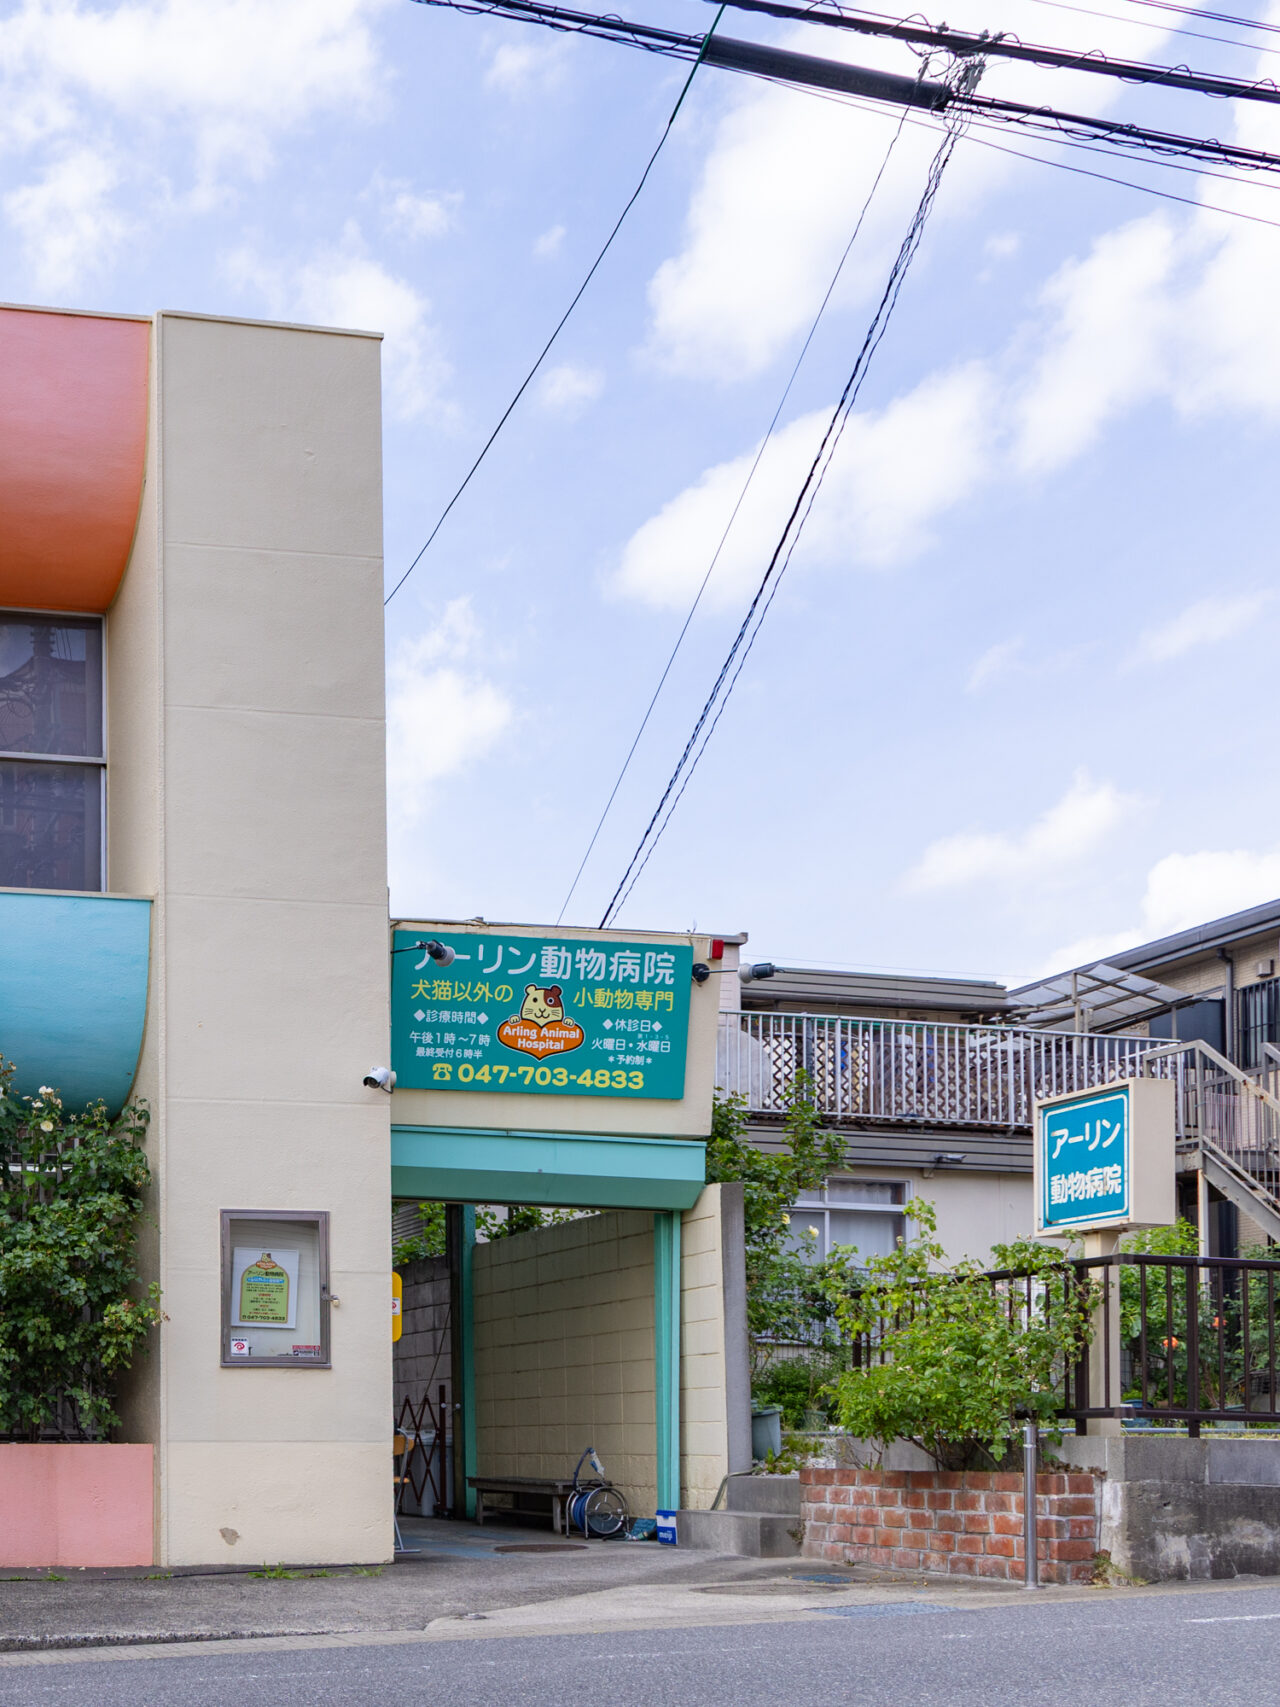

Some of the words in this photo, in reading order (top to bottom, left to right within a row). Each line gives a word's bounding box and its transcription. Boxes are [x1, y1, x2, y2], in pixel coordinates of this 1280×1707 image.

[410, 978, 513, 1003] 犬猫以外の
[573, 986, 674, 1012] 小動物専門
[426, 1009, 477, 1025] 診療時間
[614, 1018, 652, 1033] 休診日
[503, 1025, 537, 1039] Arling
[540, 1027, 579, 1039] Animal
[517, 1037, 564, 1051] Hospital
[458, 1064, 644, 1089] 047-703-4833
[1050, 1118, 1121, 1159] アーリン
[1050, 1163, 1122, 1205] 動物病院
